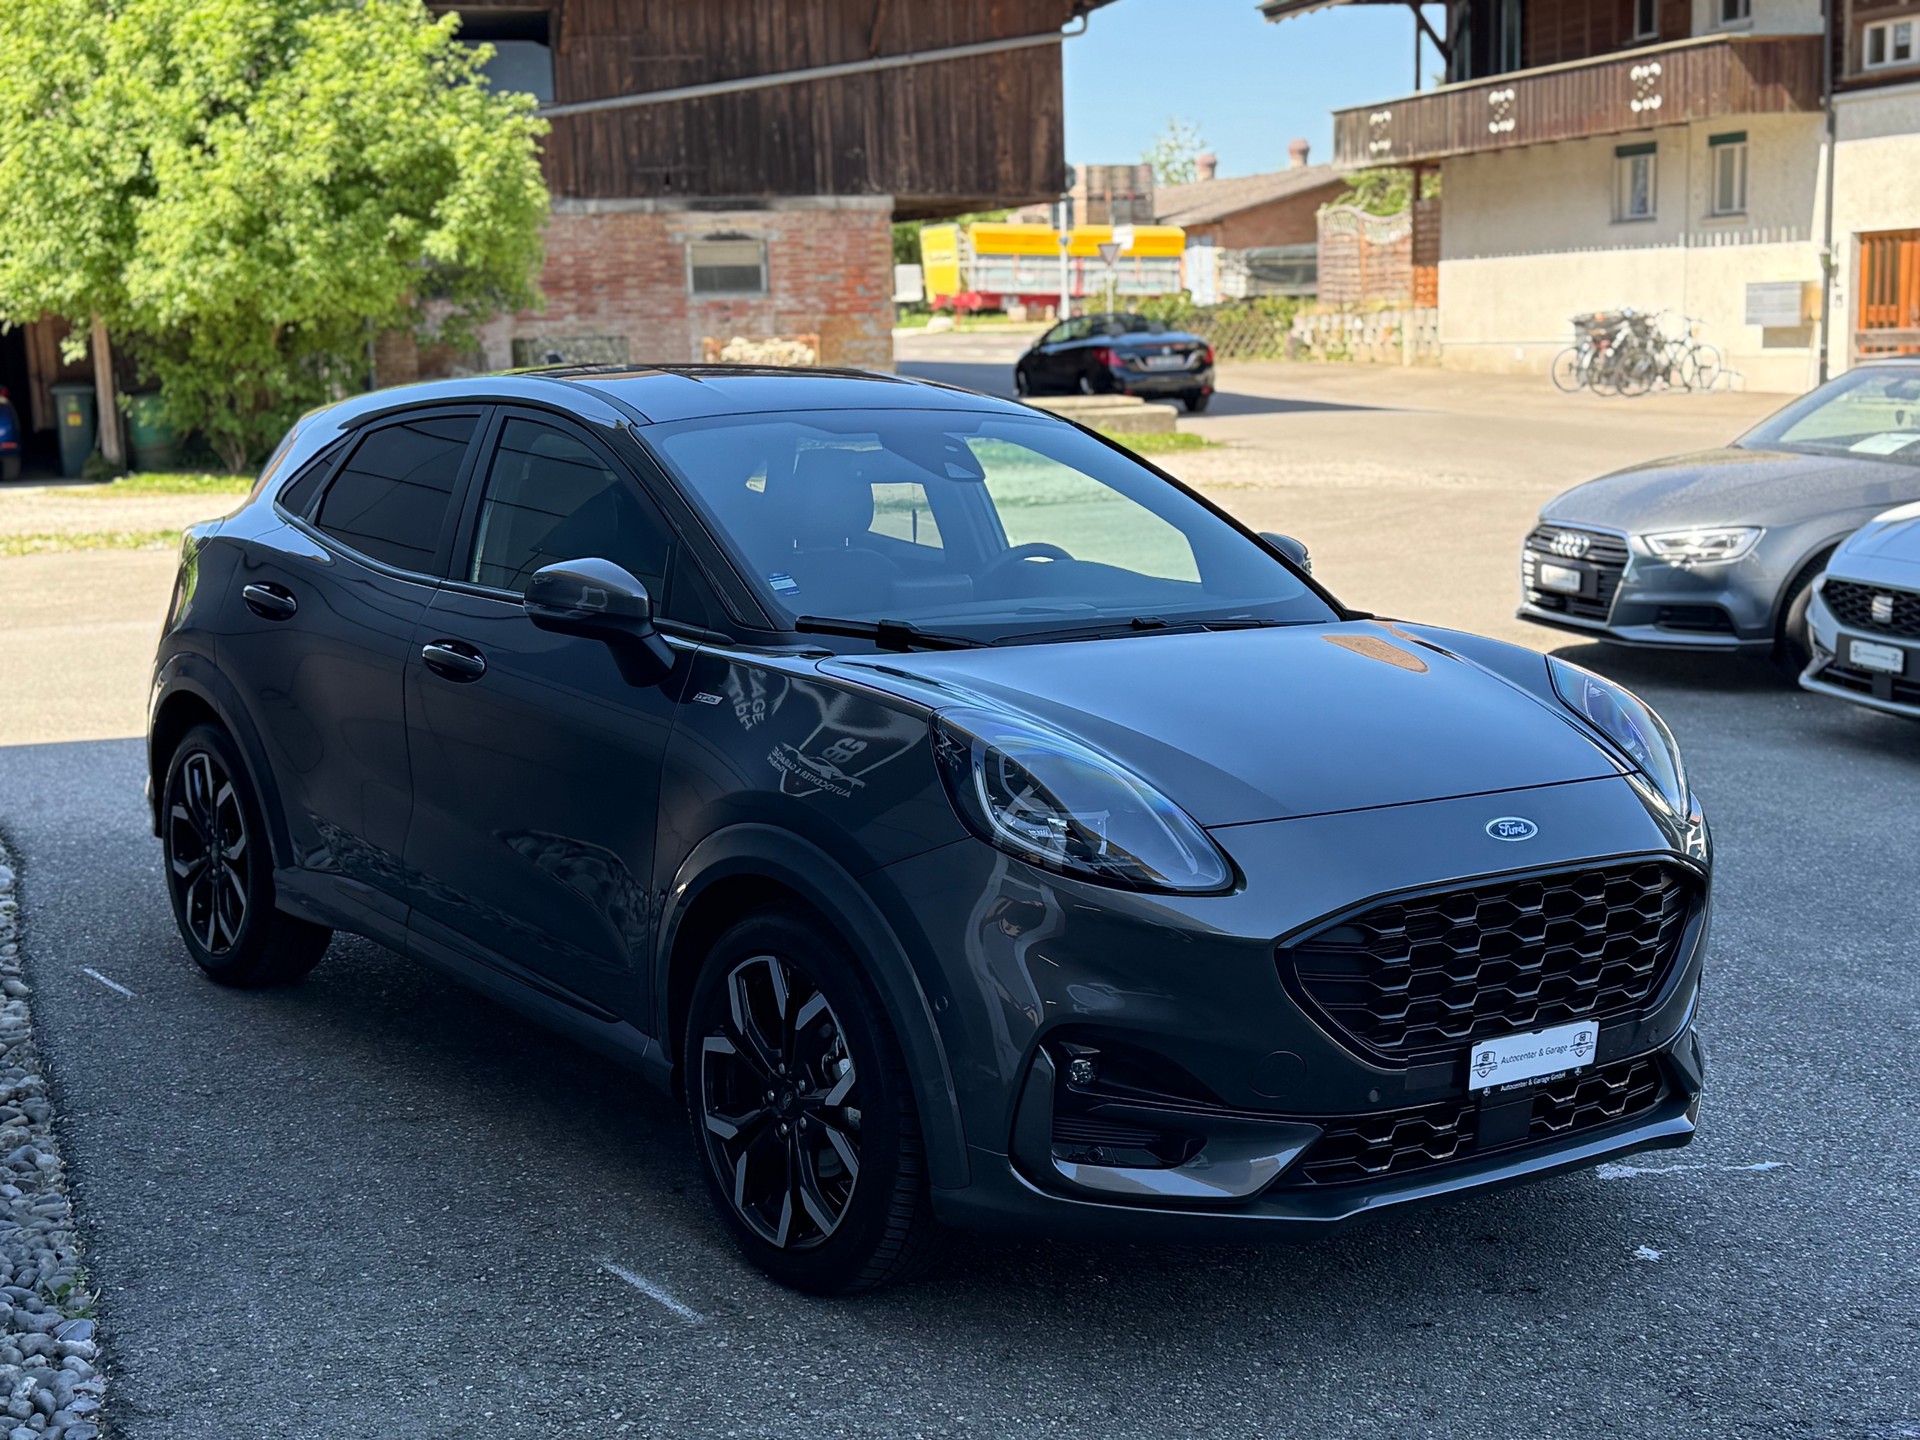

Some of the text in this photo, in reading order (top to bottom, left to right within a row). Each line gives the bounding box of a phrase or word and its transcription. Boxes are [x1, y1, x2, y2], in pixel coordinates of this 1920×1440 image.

[1498, 821, 1528, 836] Ford
[1501, 1044, 1568, 1064] Autocenter & Garage
[1500, 1081, 1527, 1092] Autocenter
[1533, 1076, 1550, 1085] Garage
